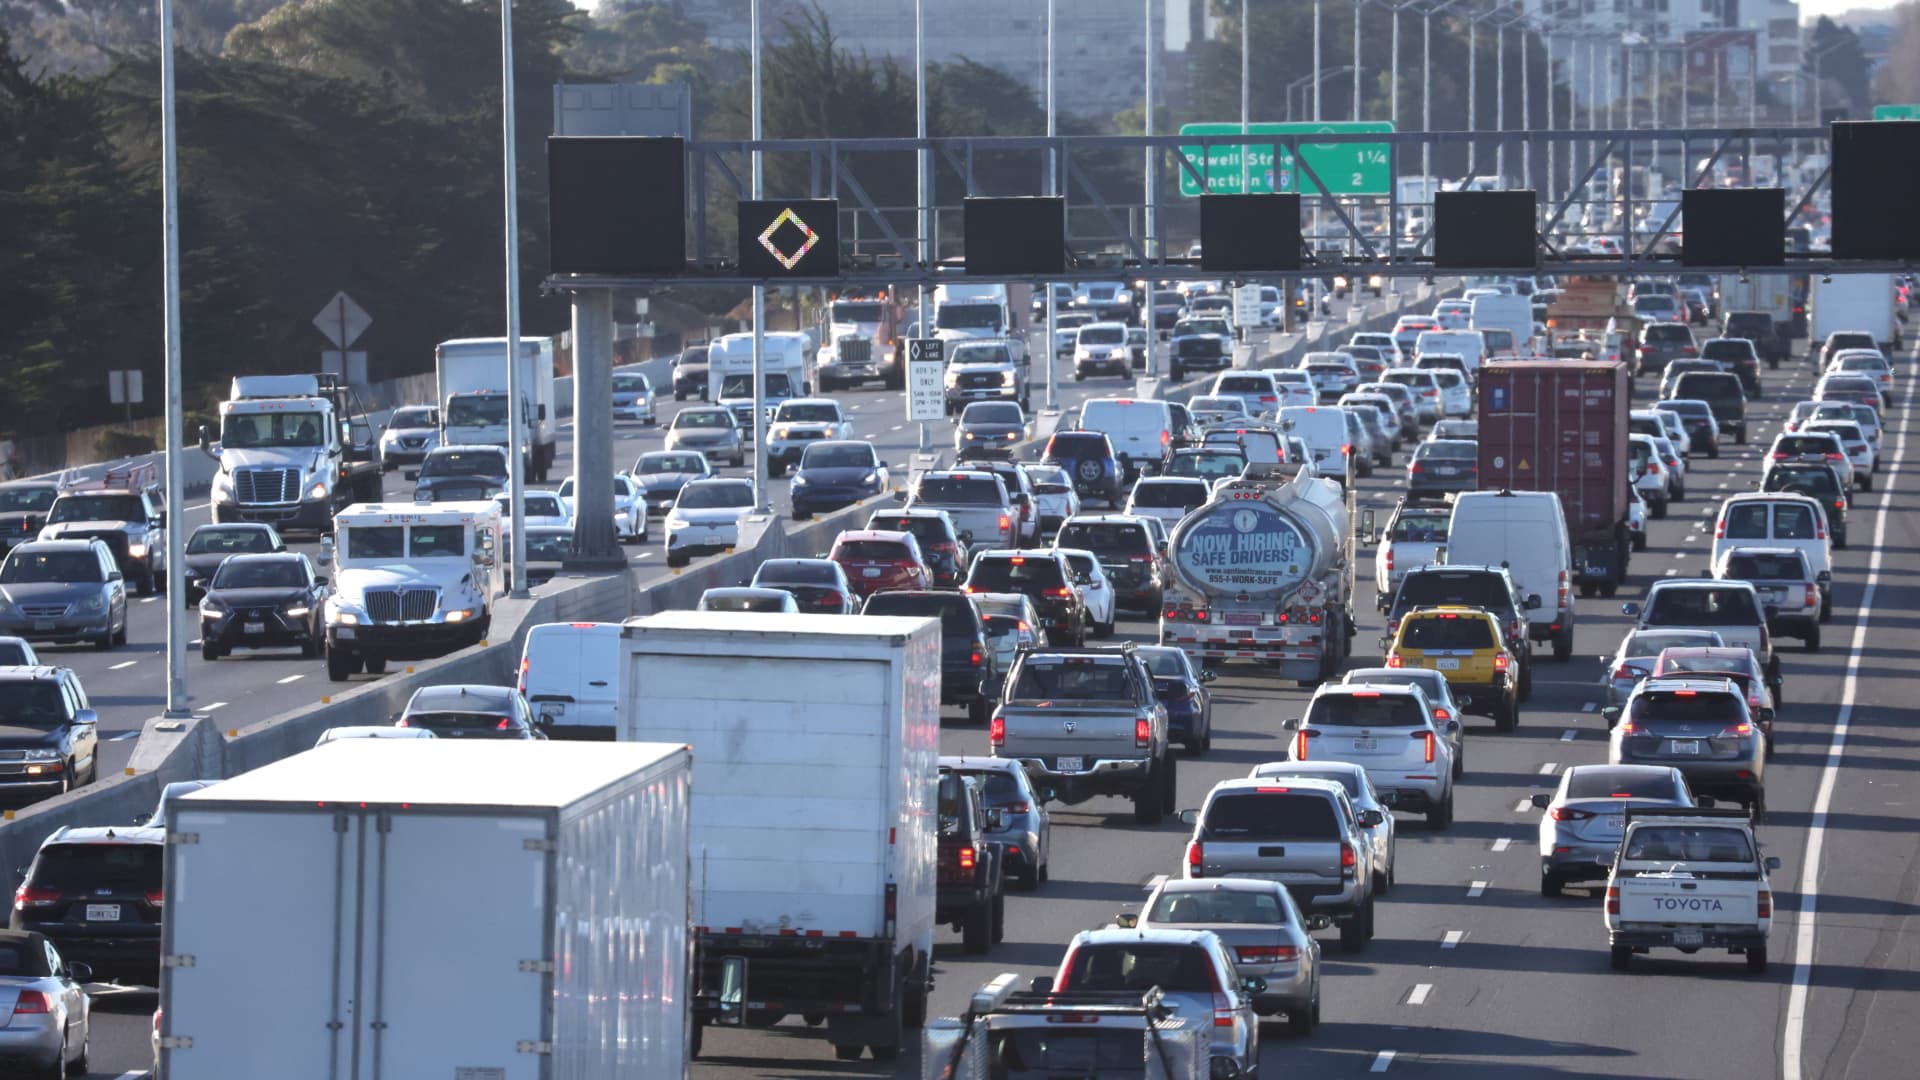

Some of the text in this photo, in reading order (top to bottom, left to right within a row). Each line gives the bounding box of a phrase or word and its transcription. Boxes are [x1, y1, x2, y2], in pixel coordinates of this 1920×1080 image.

[1186, 174, 1261, 188] Jnctin
[1351, 172, 1364, 187] 2
[920, 377, 934, 386] ONLY
[1192, 531, 1295, 553] NOW HIRING
[1191, 548, 1295, 566] SAFE DRIVERS!
[1653, 897, 1723, 912] TOYOTA
